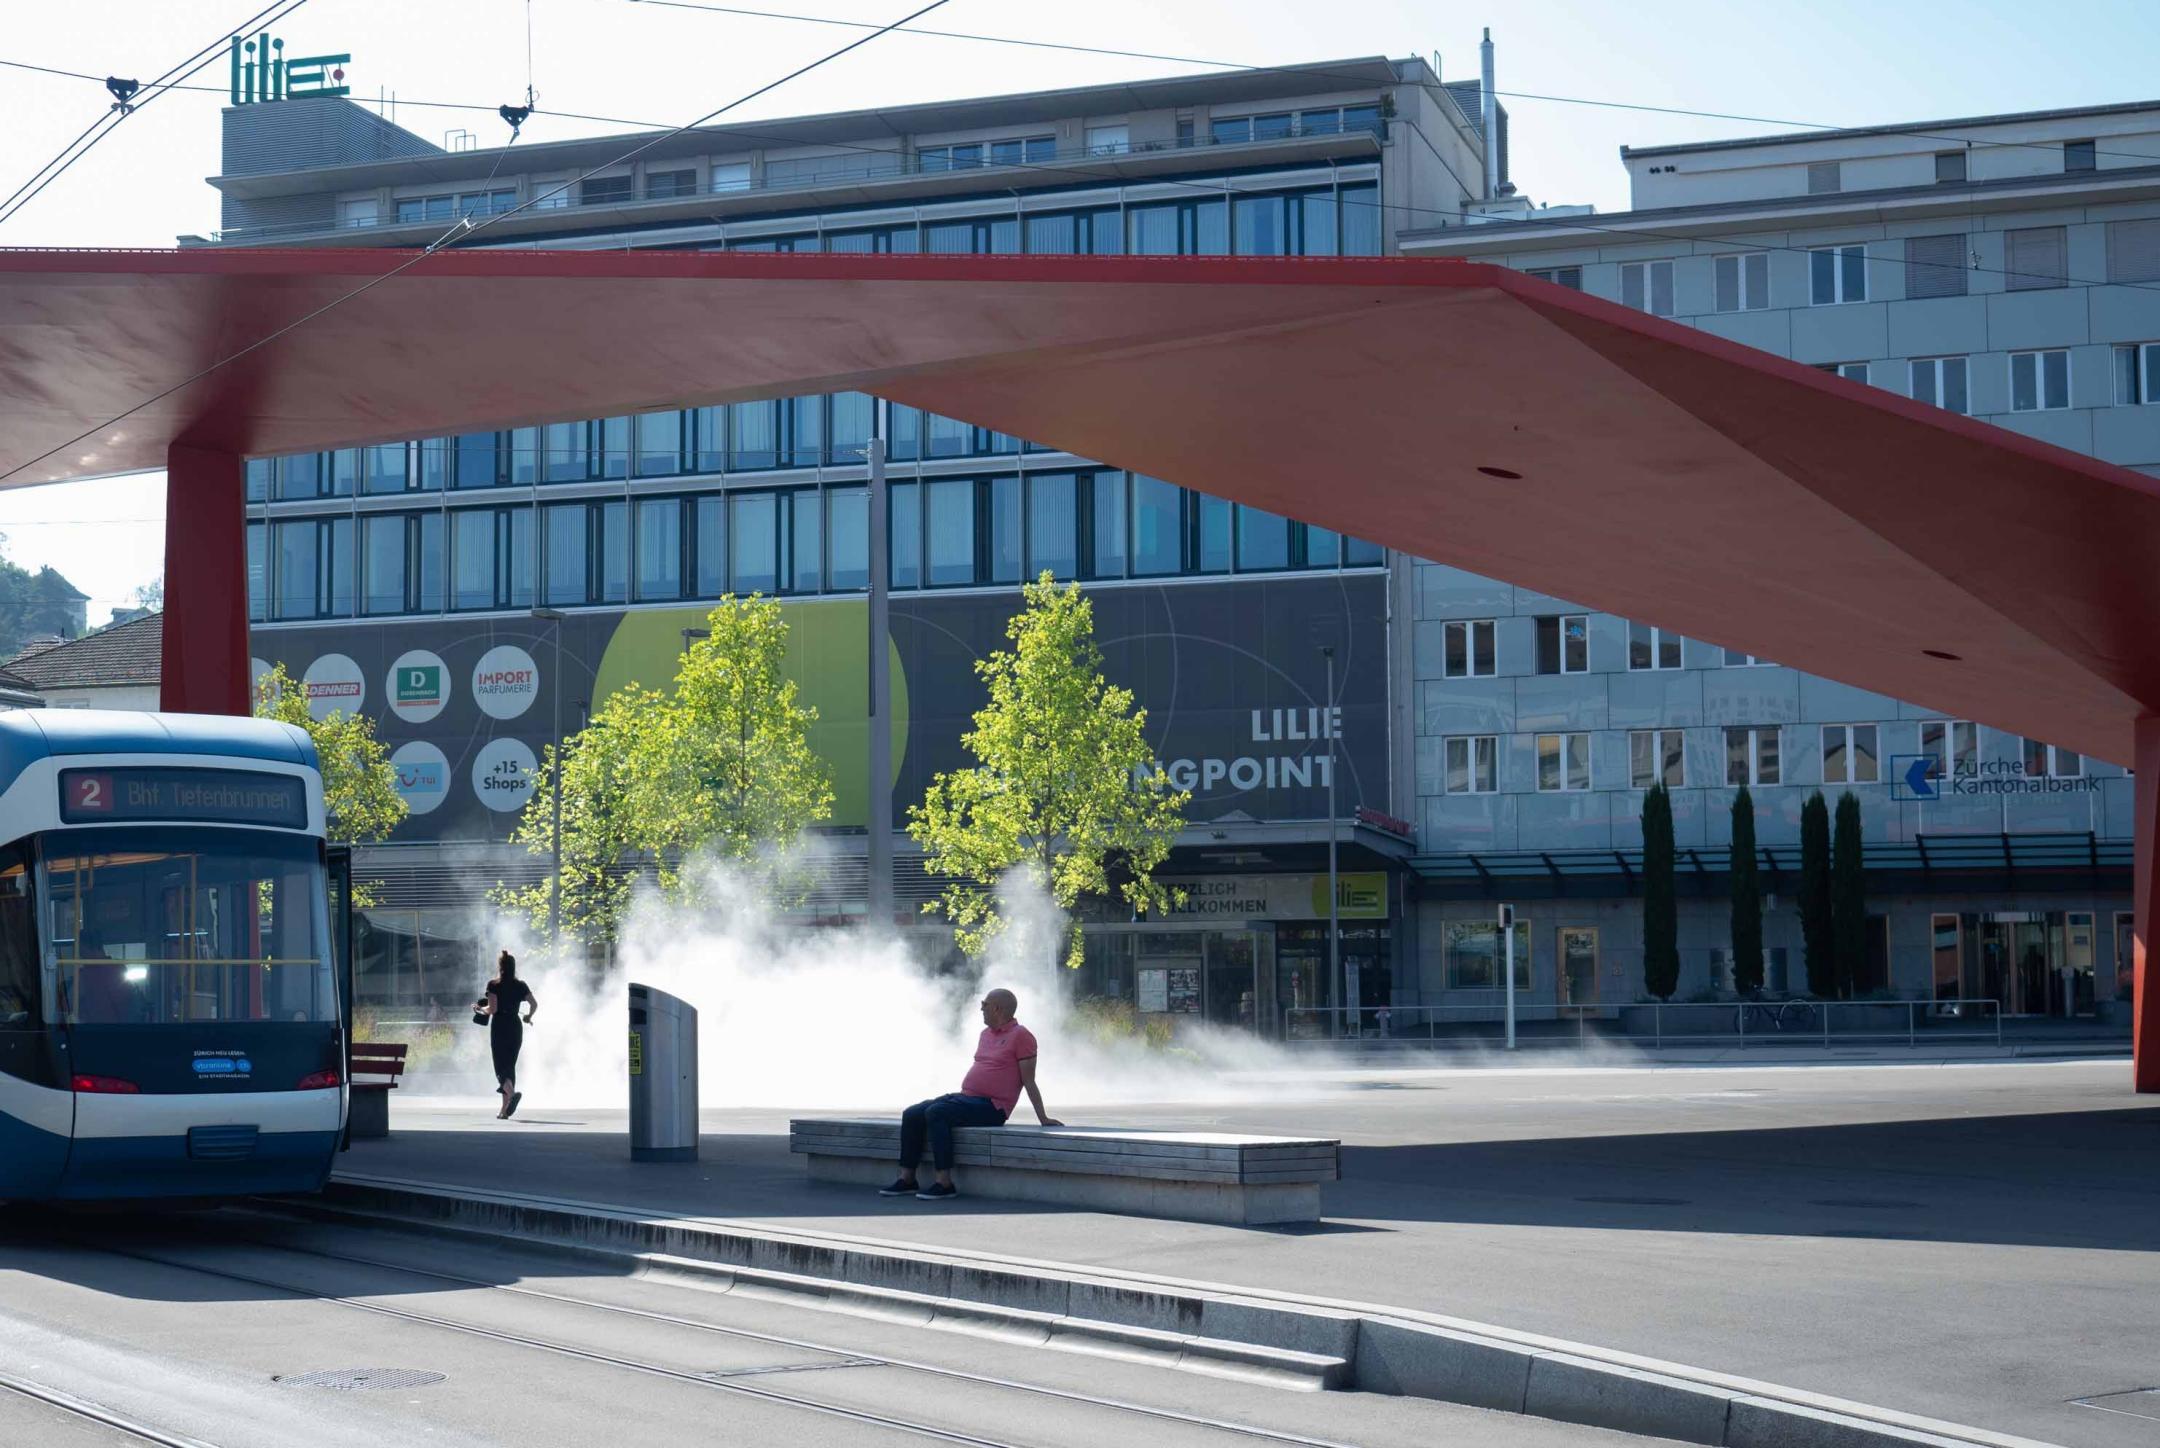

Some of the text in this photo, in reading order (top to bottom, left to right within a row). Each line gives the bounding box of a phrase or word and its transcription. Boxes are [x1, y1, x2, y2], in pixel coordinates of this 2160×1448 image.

[410, 671, 426, 688] D
[478, 670, 532, 684] IMPORT
[309, 684, 358, 696] DENNER
[478, 683, 532, 694] PARFUMERIE
[1251, 706, 1342, 741] LILIE
[493, 760, 518, 775] +15
[1953, 756, 2032, 775] Zürcher
[420, 776, 436, 785] TUI
[483, 776, 527, 792] Shops
[1953, 773, 2100, 795] Kantonalbank
[81, 779, 102, 807] 2
